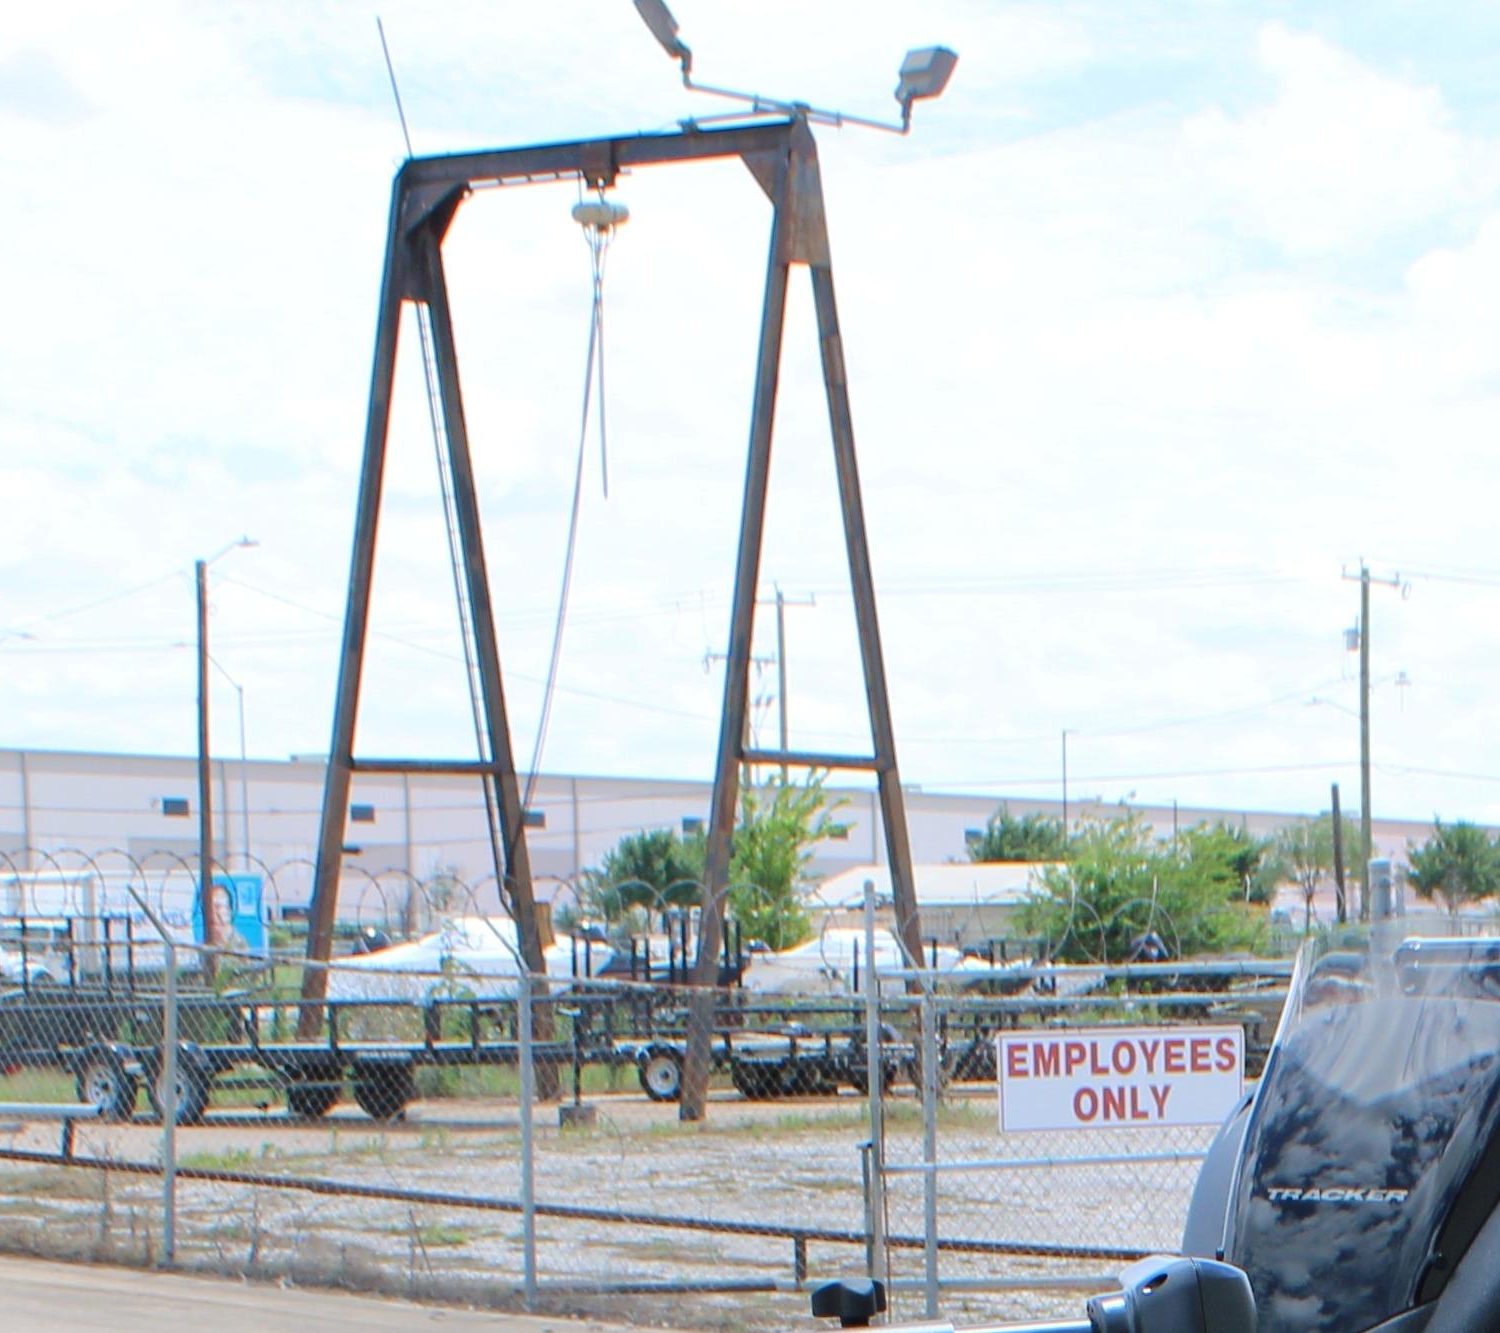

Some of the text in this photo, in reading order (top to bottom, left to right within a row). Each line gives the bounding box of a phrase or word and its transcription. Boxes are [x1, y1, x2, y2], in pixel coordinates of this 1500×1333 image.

[1007, 1038, 1236, 1078] EMPLOYEES
[1073, 1084, 1172, 1122] ONLY
[1268, 1187, 1409, 1202] TRACKER
